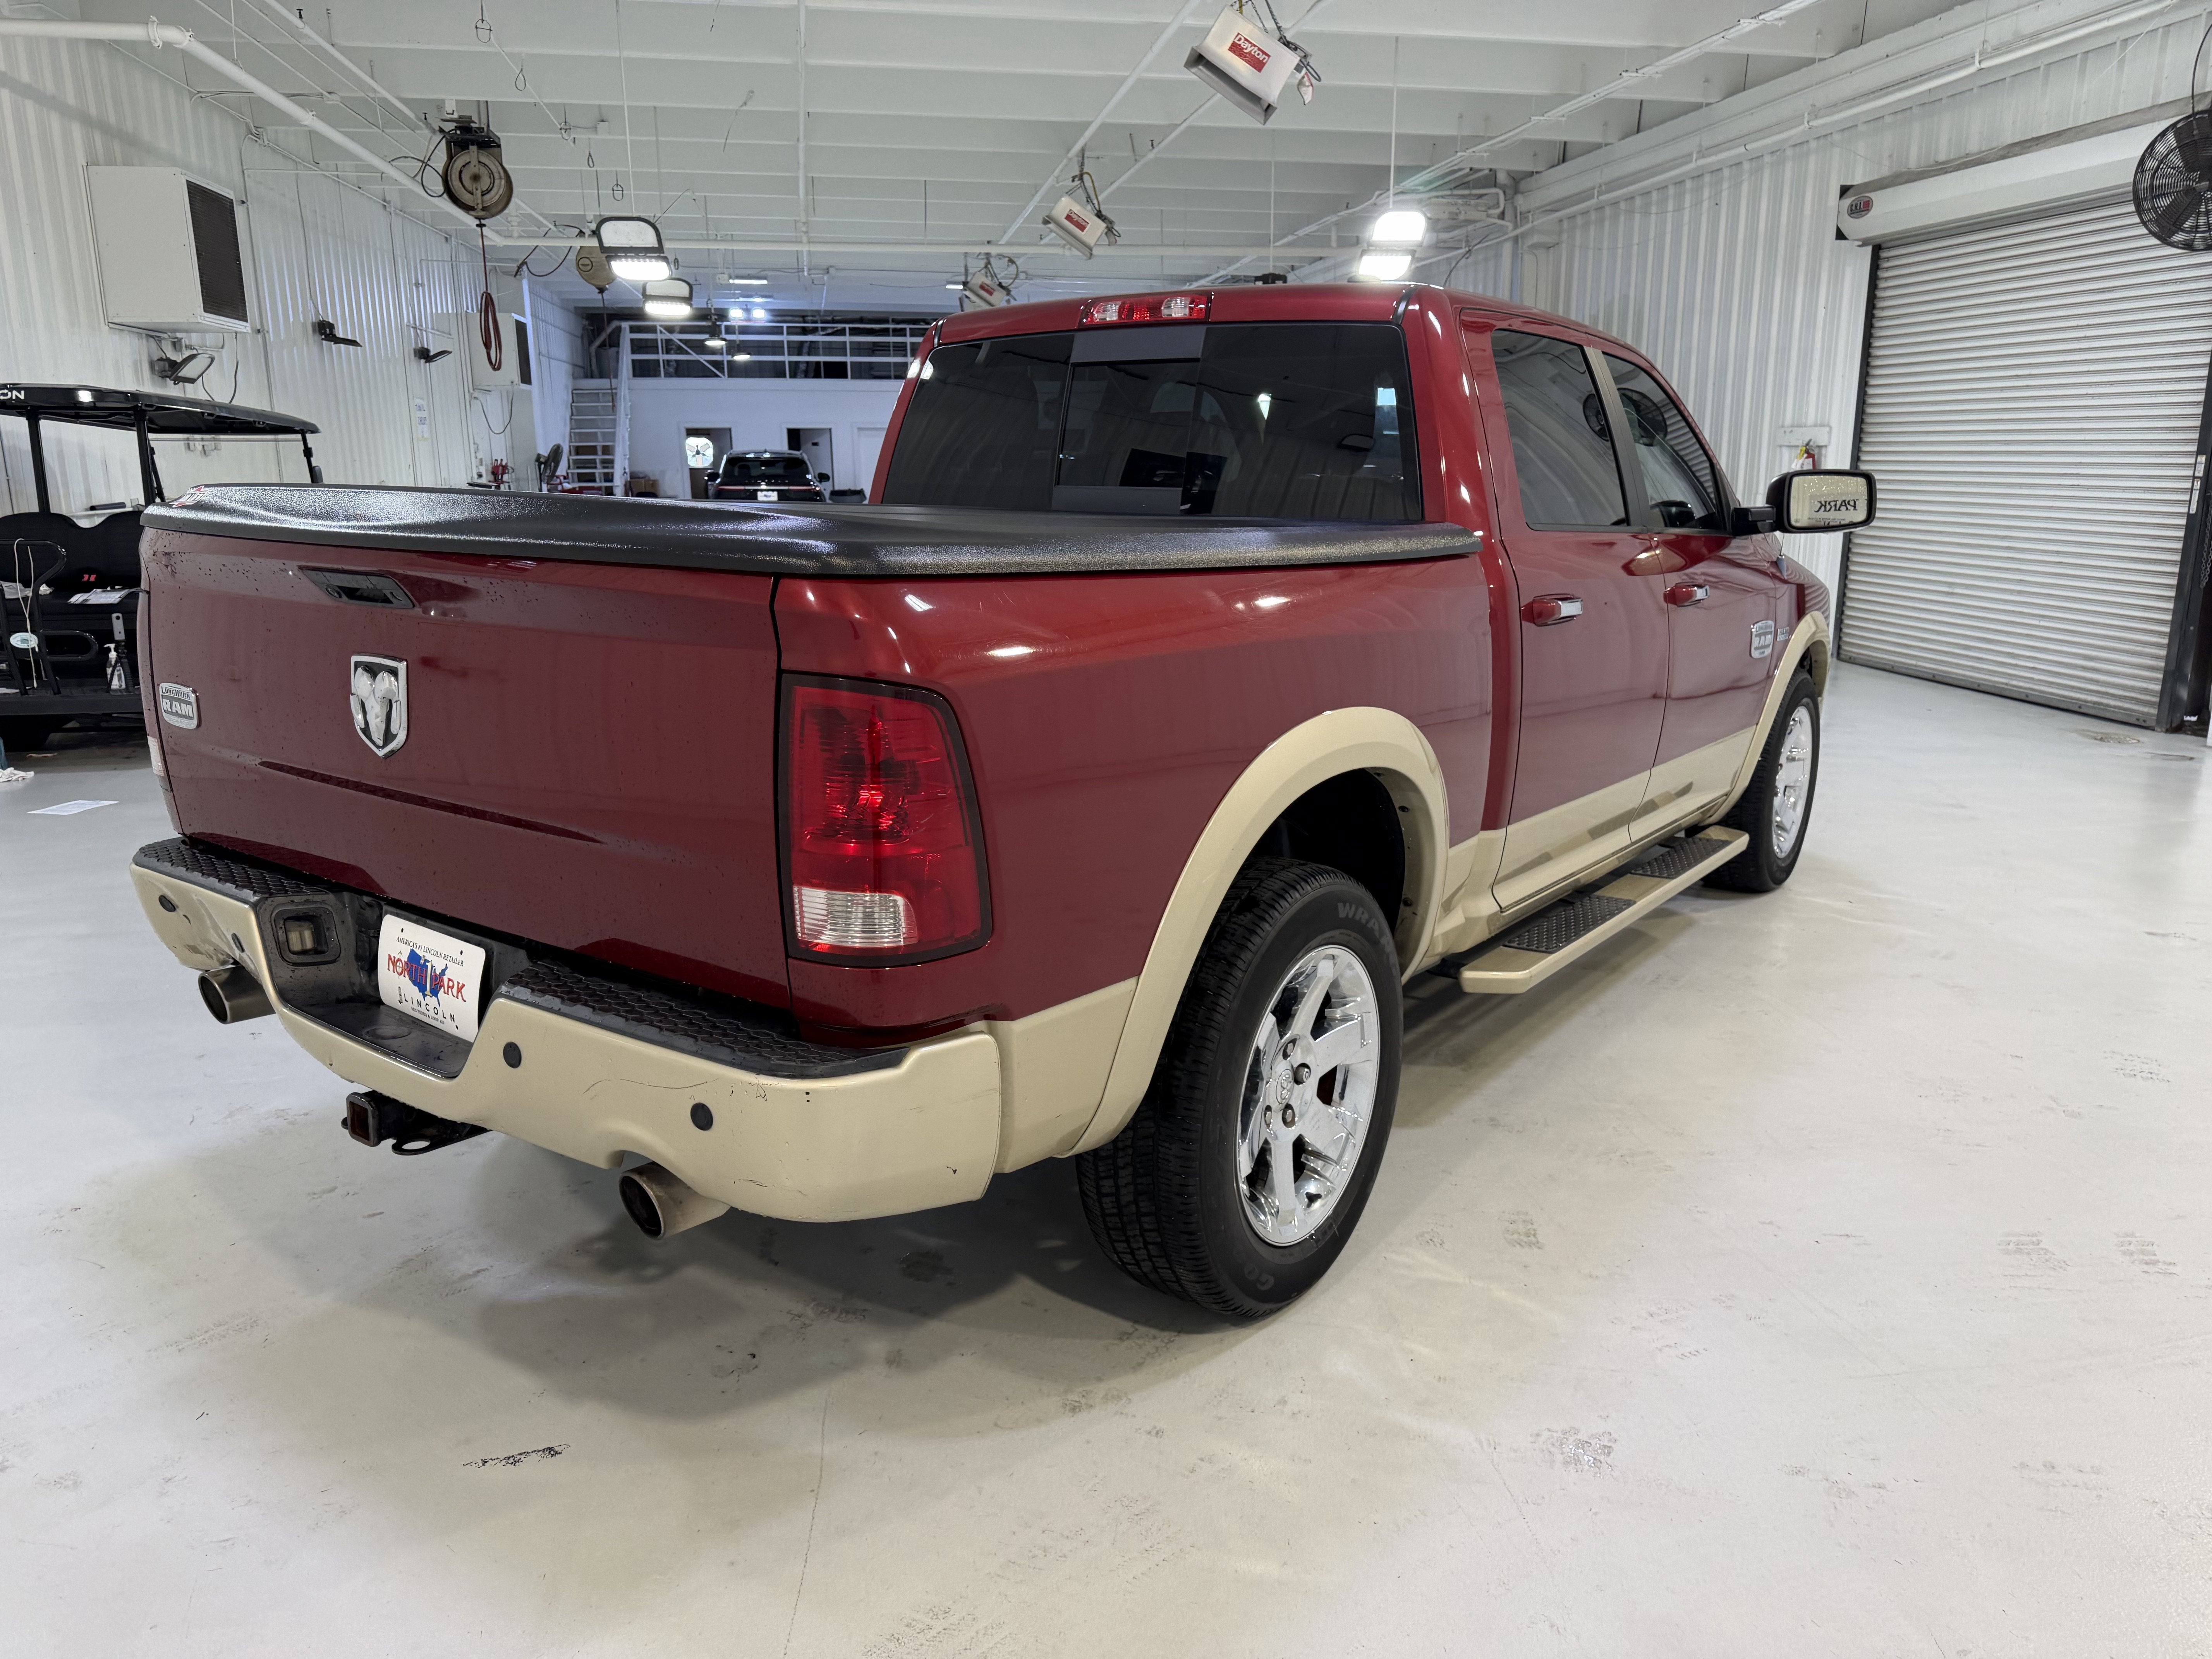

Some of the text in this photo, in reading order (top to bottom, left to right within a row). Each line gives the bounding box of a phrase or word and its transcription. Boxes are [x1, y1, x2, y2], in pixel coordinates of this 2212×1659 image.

[1233, 34, 1268, 63] Dayton
[162, 699, 194, 717] RAM
[396, 936, 418, 949] AMERICA'S
[423, 946, 443, 959] LINCOLN
[443, 953, 464, 967] RETAILER
[387, 953, 426, 985] NORTH
[432, 972, 467, 1003] PARK
[404, 993, 455, 1023] LINCOLN
